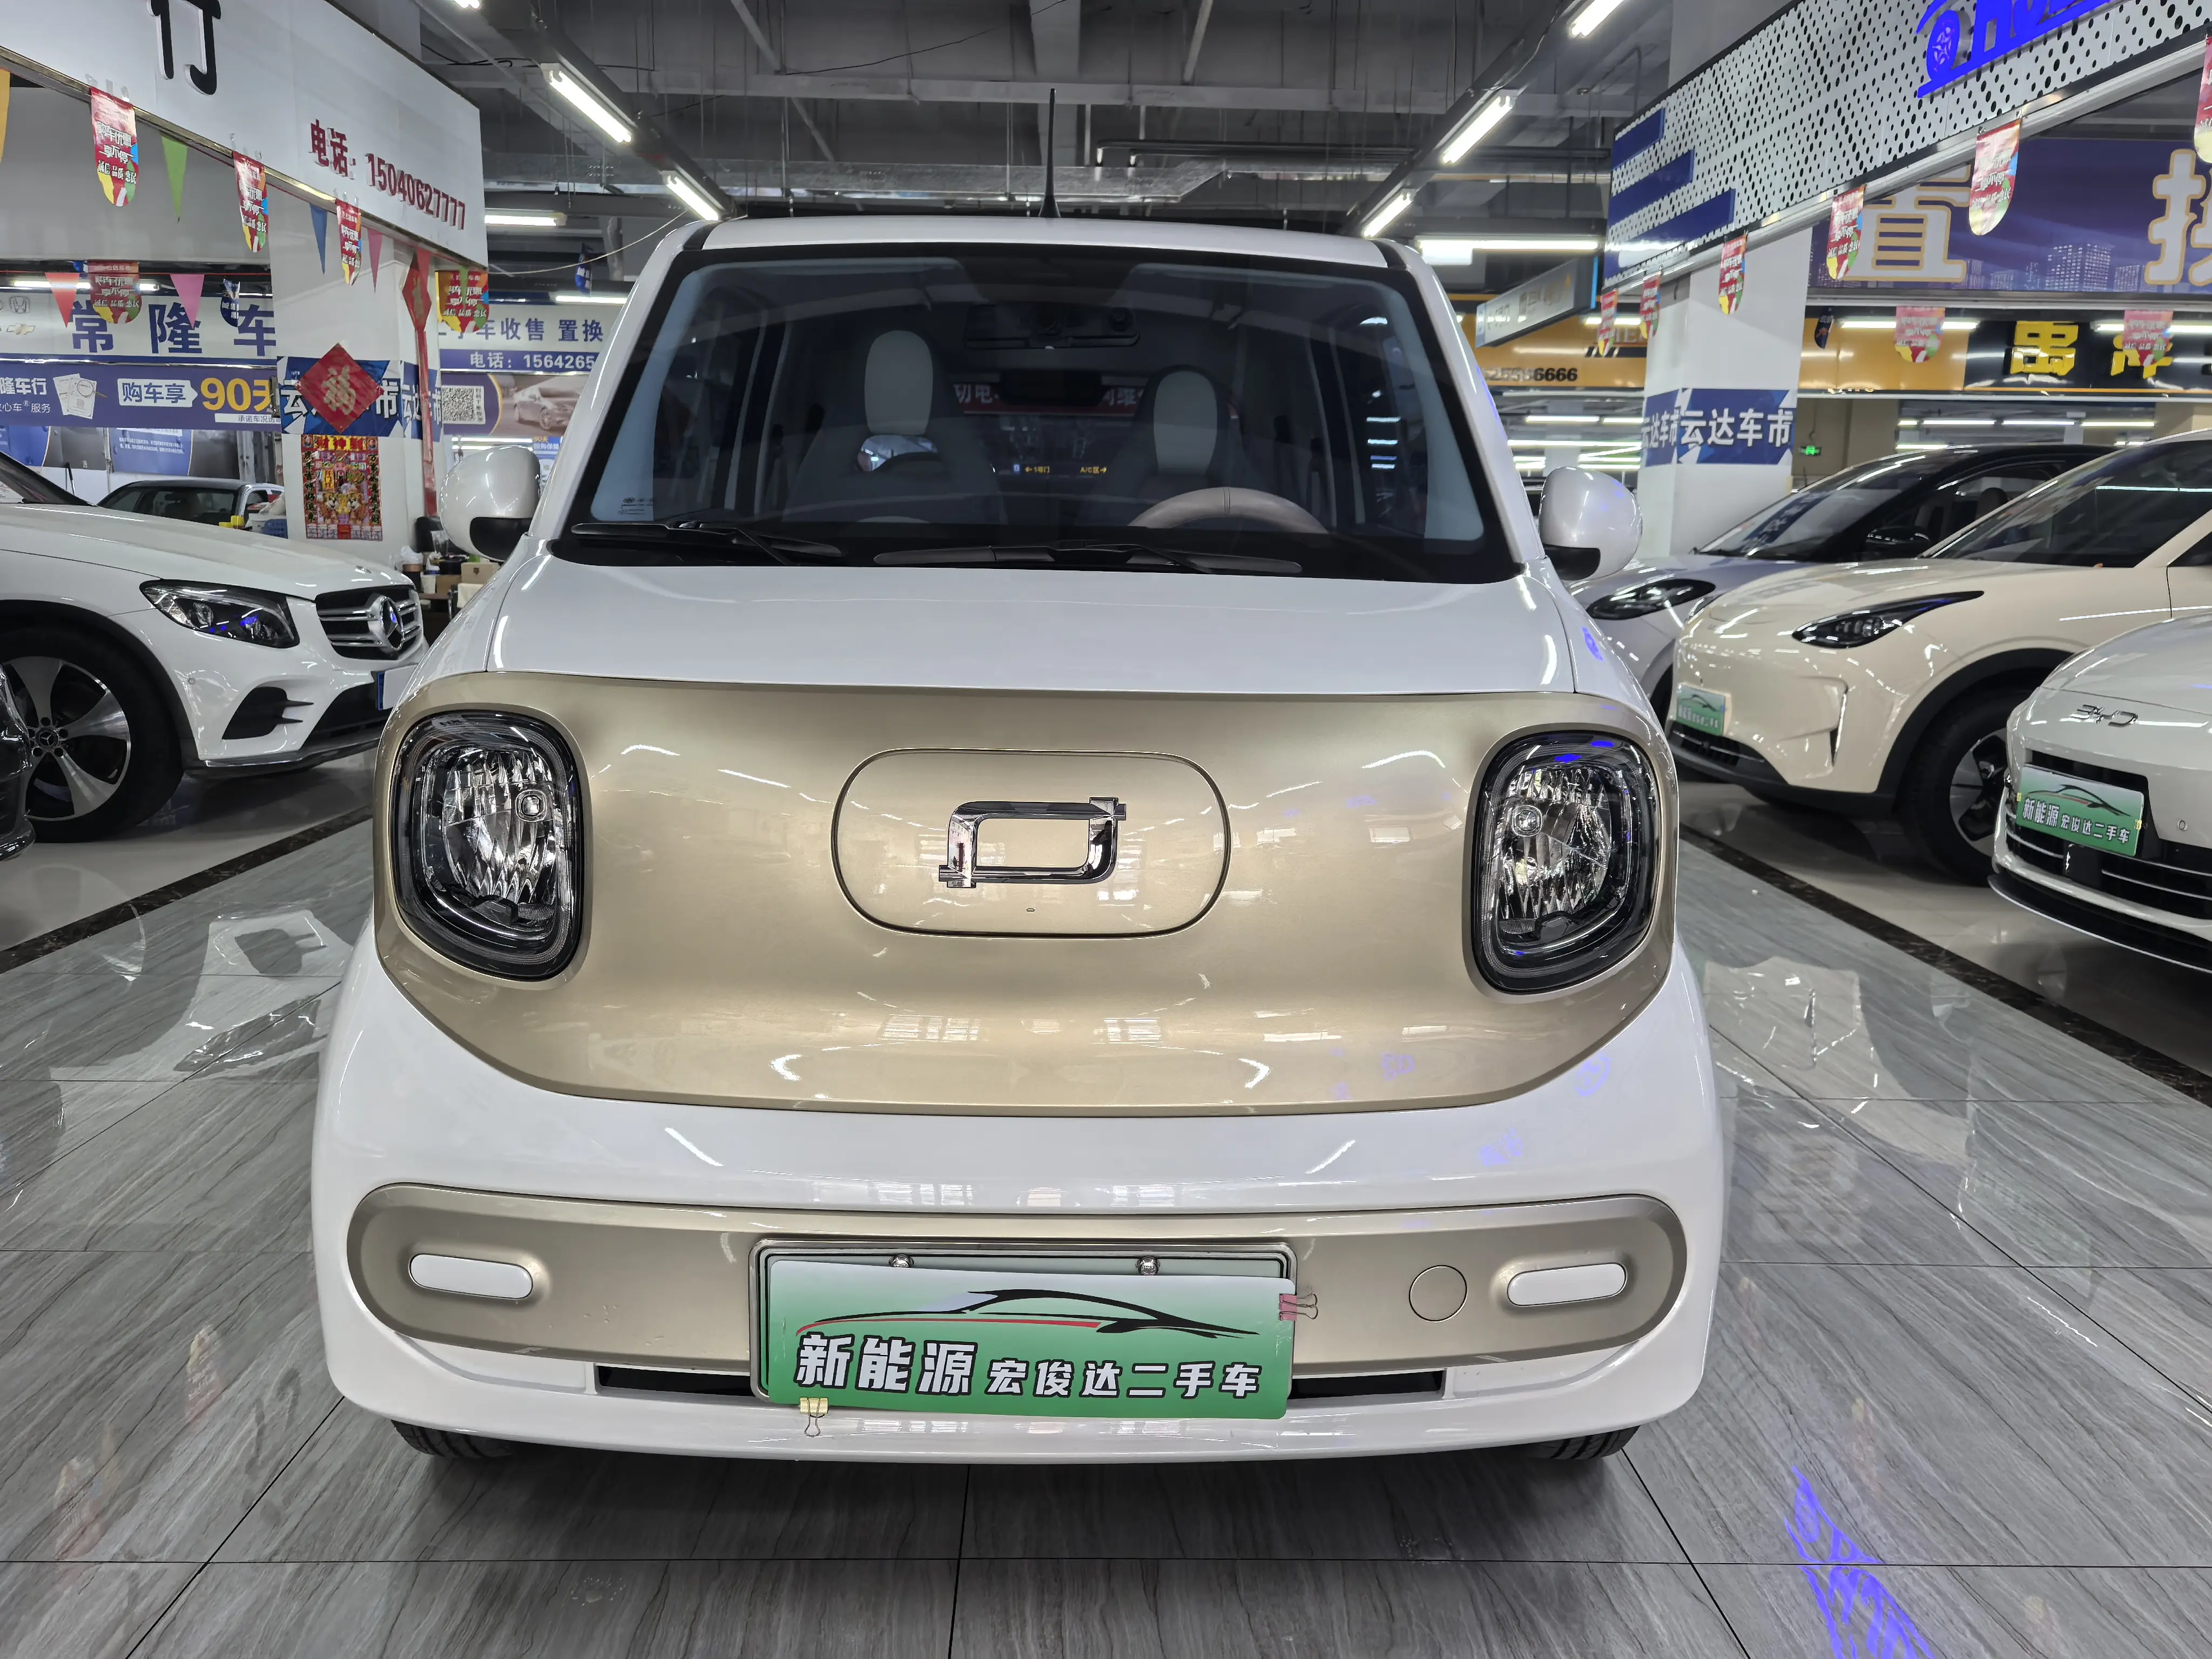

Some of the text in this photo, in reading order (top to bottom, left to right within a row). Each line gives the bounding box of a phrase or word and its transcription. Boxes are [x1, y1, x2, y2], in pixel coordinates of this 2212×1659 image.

[365, 153, 466, 231] 15040627777
[71, 300, 276, 356] 常隆车
[439, 318, 603, 342] 车收售 置换
[523, 354, 596, 369] 1564265
[0, 376, 48, 395] 隆车行
[122, 382, 186, 403] 购车享
[1681, 408, 1793, 448] 云达车市
[2022, 798, 2060, 827] 新能源
[794, 1332, 1263, 1400] 新能源 宏俊达二手车
